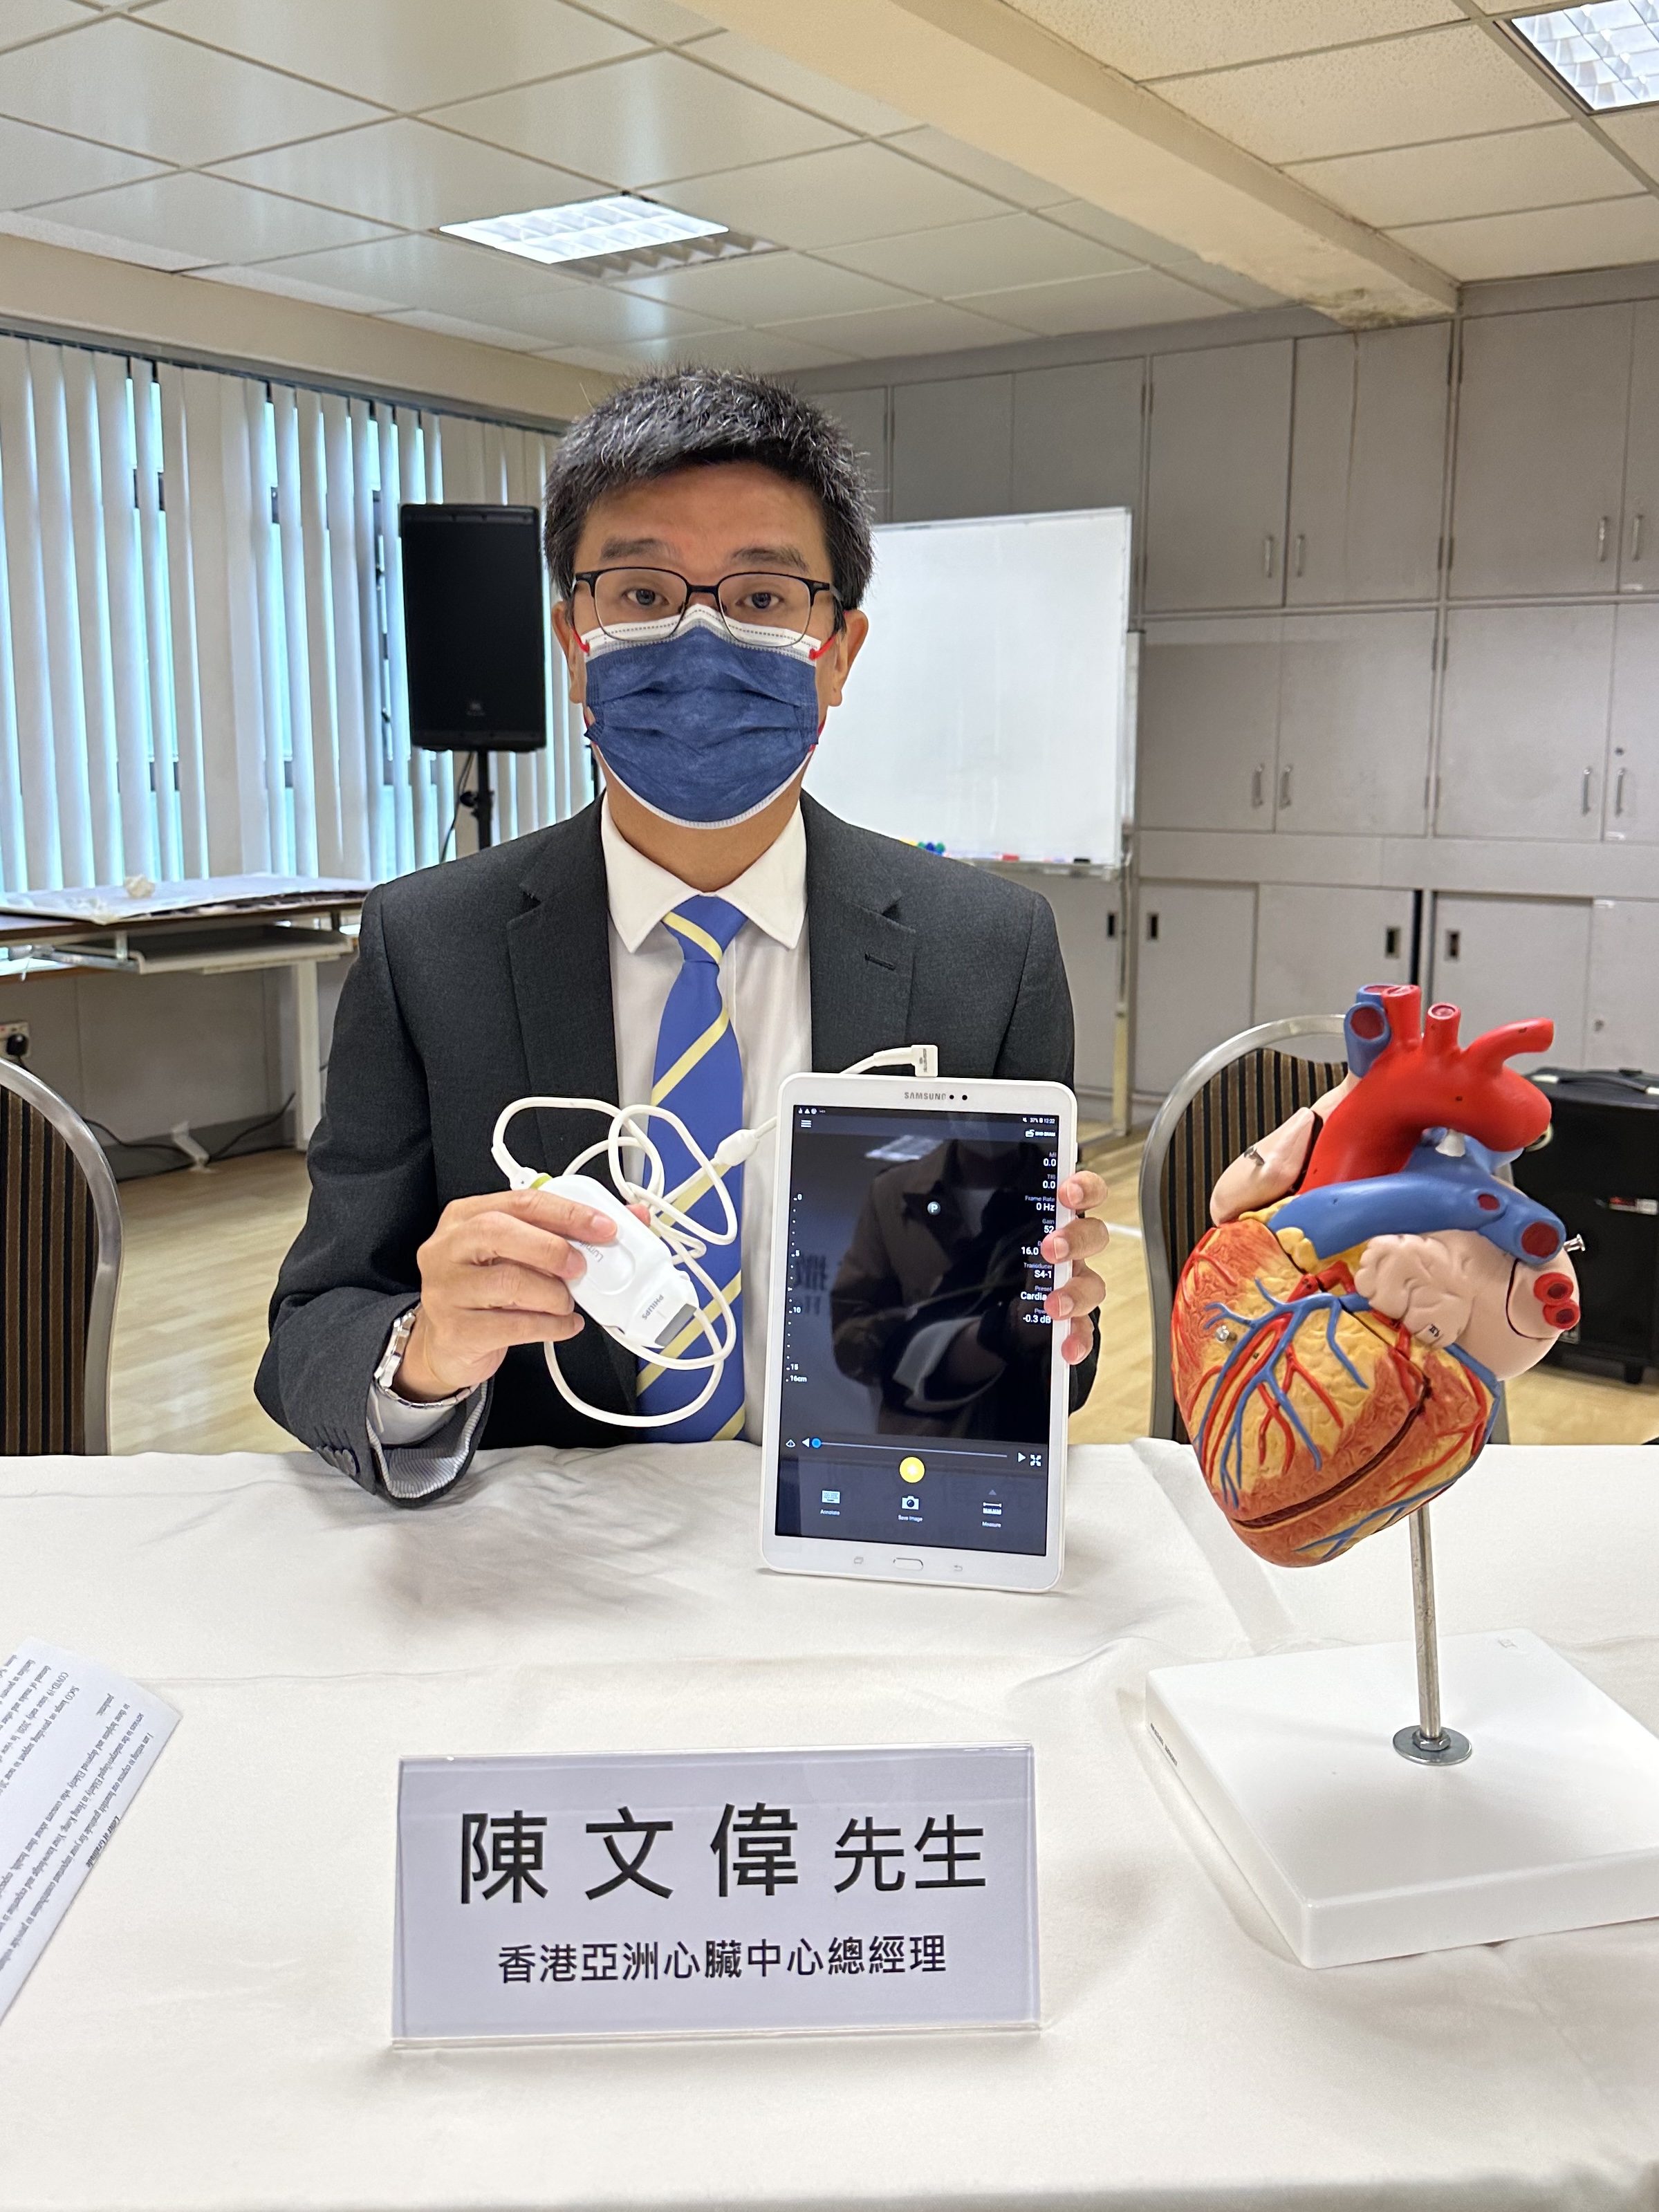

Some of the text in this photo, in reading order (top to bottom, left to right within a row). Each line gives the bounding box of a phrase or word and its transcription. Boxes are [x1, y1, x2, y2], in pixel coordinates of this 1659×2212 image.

[904, 1091, 947, 1101] SAMSUNG
[1043, 1158, 1057, 1167] 0.0
[1042, 1180, 1056, 1189] 0.0
[1036, 1202, 1055, 1211] 0 Hz
[1044, 1225, 1055, 1234] 52
[579, 1240, 604, 1263] Lumif
[1021, 1247, 1039, 1255] 16.0
[1034, 1270, 1052, 1279] S4-1
[1020, 1291, 1048, 1301] Cardia
[642, 1294, 664, 1321] PHILIPS
[1022, 1314, 1052, 1323] -0.3 dB
[46, 1672, 69, 1696] COVID-19
[95, 1739, 105, 1751] and
[121, 1735, 131, 1744] the
[130, 1743, 146, 1760] writing
[67, 1769, 86, 1790] Elderly
[117, 1764, 131, 1783] express
[84, 1777, 103, 1797] Elderly
[111, 1781, 120, 1792] our
[60, 1789, 71, 1801] who
[70, 1801, 88, 1817] Hong
[52, 1833, 67, 1848] Your
[78, 1832, 89, 1843] for
[70, 1840, 82, 1857] your
[32, 1846, 57, 1877] knowledge
[24, 1876, 35, 1890] and
[497, 1934, 947, 1986] 香港亞洲心臟中心總經理
